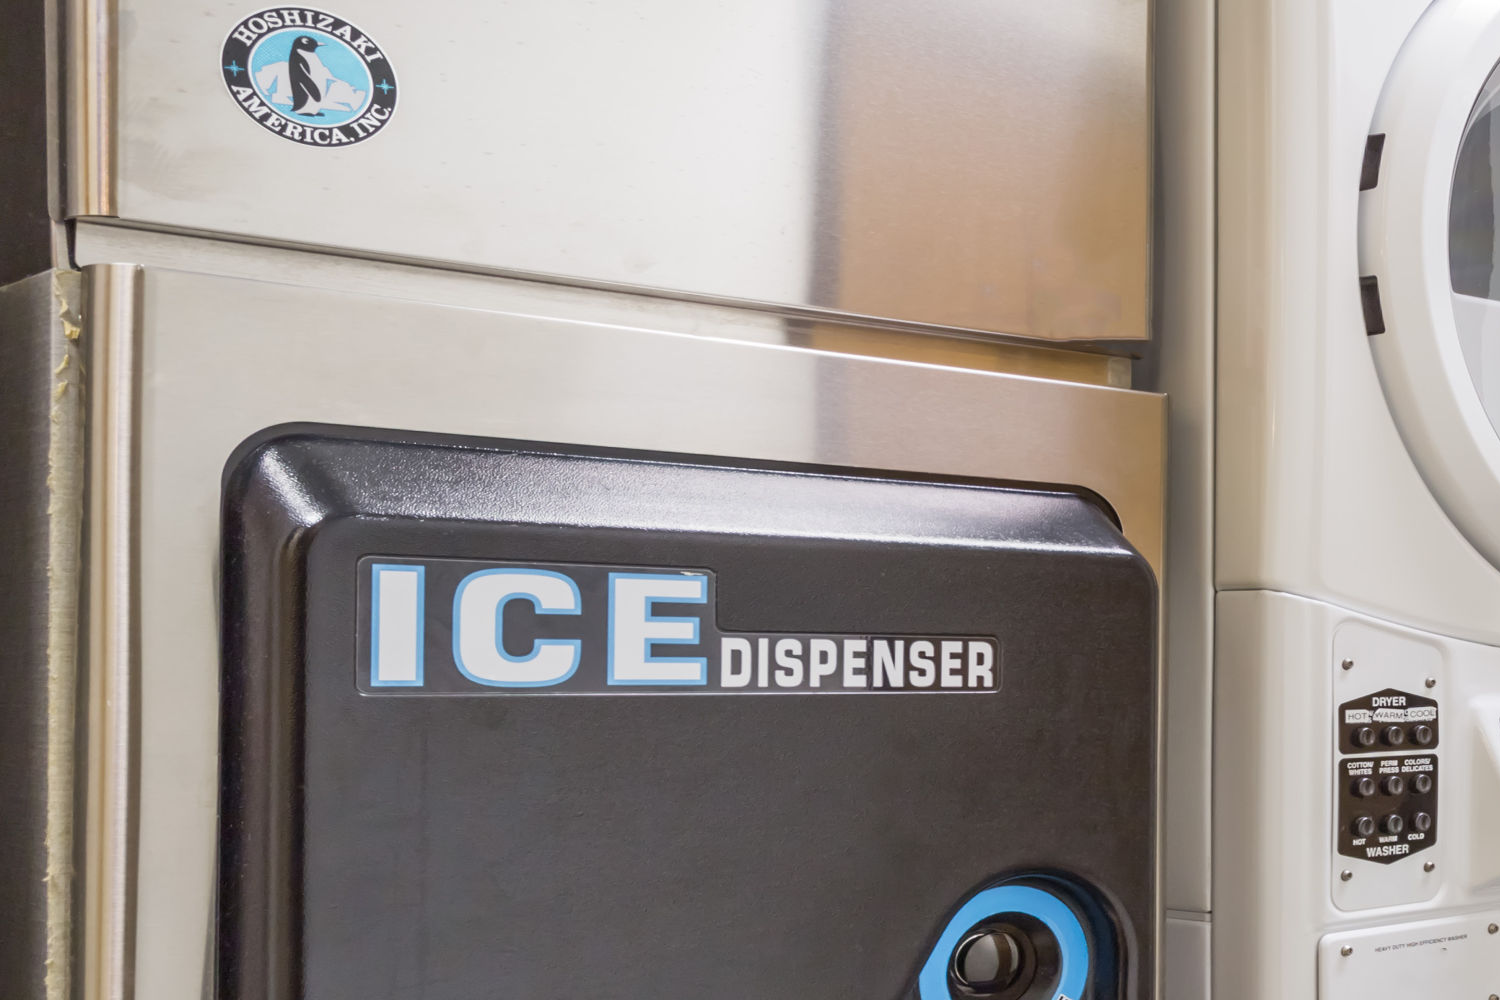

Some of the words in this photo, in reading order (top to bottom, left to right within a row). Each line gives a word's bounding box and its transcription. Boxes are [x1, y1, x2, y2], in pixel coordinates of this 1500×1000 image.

[232, 9, 384, 64] HOSHIZAKI
[352, 103, 392, 138] INC.
[370, 563, 708, 688] ICE
[720, 636, 994, 689] DISPENSER
[1372, 696, 1406, 707] DRYER
[1348, 712, 1367, 720] HOT
[1375, 711, 1402, 719] WARM
[1349, 768, 1373, 776] WHITES
[1379, 766, 1400, 774] PRESS
[1352, 838, 1366, 846] HOT
[1379, 835, 1398, 843] WARM
[1407, 832, 1425, 840] COLD
[1366, 844, 1410, 858] WASHER
[1419, 938, 1447, 946] EFFICIENCY
[1447, 933, 1468, 941] WASHER
